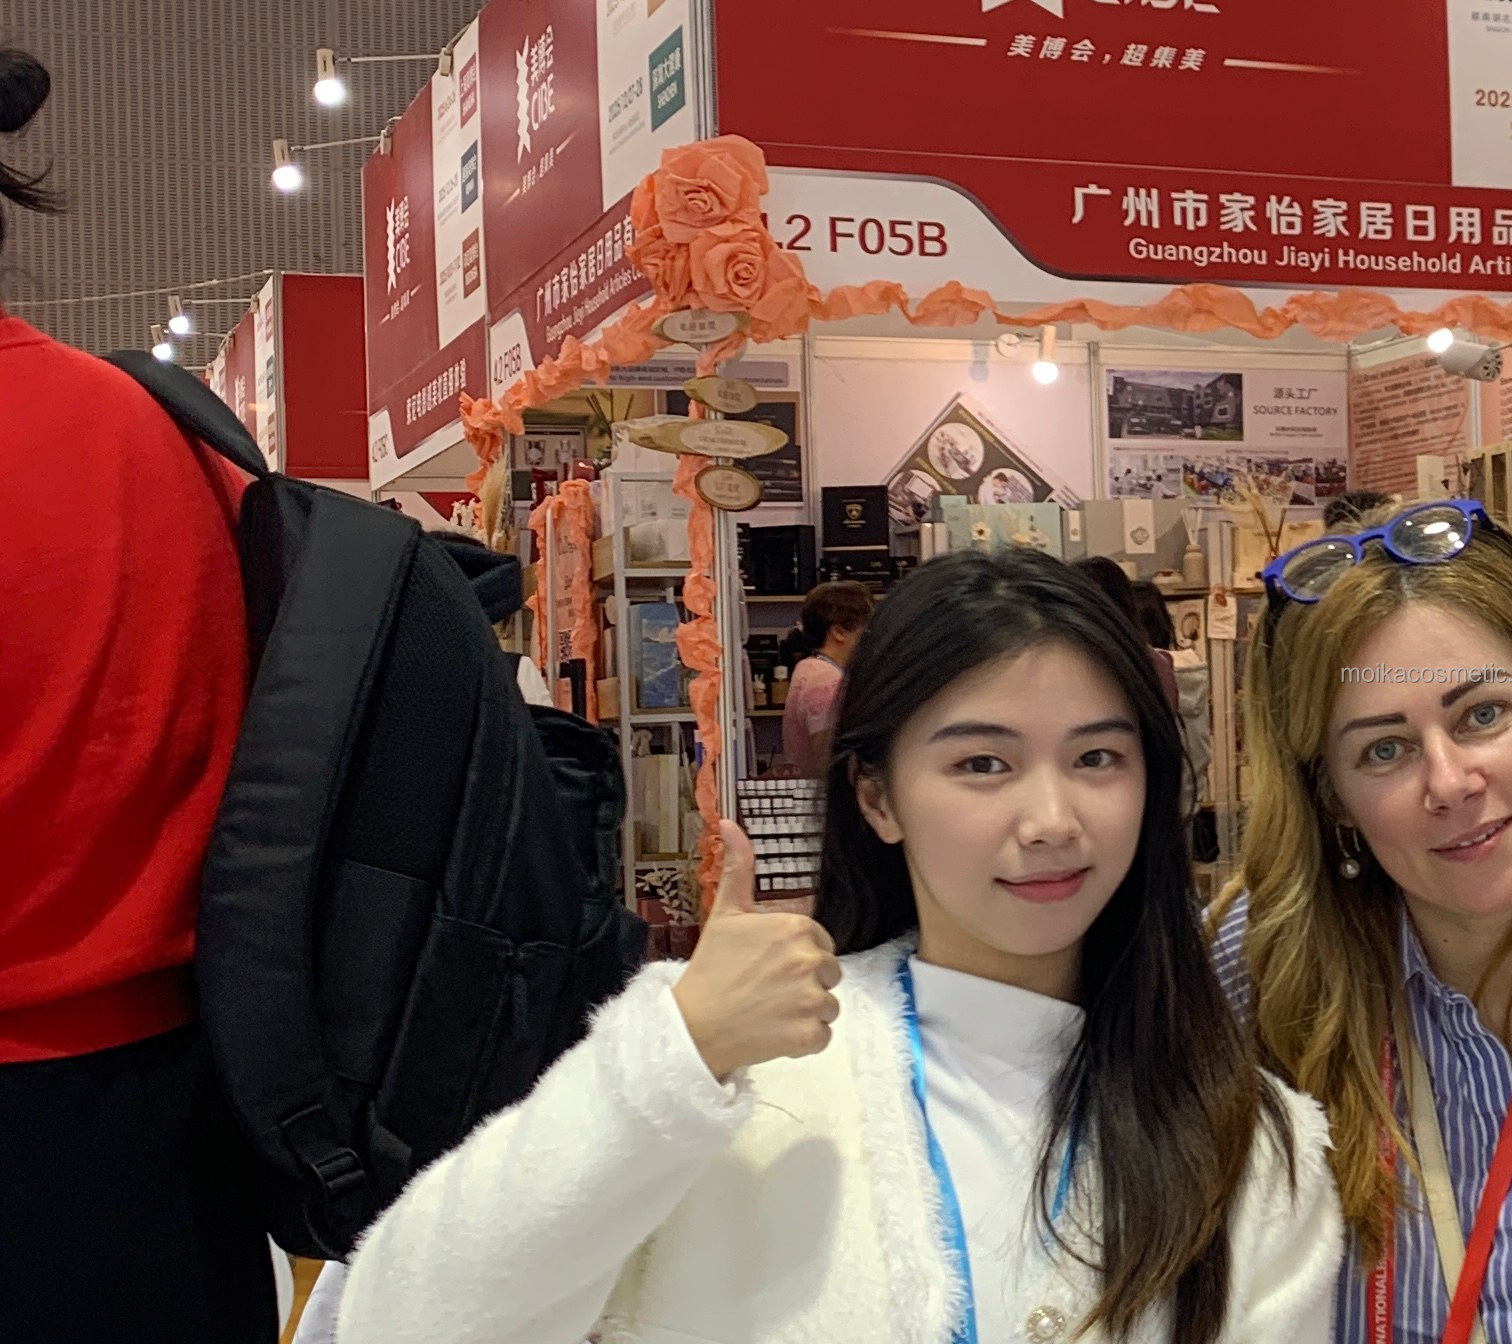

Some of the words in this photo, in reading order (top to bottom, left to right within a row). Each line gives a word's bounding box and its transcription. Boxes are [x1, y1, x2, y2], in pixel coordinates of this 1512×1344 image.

[828, 216, 948, 257] F05B
[536, 214, 636, 323] 广州市家怡家居日用品有
[1129, 238, 1267, 268] Guangzhou
[1275, 244, 1332, 272] Jiayi
[1338, 247, 1461, 274] Household
[1253, 406, 1293, 416] SOURCE
[1294, 406, 1338, 417] FACTORY
